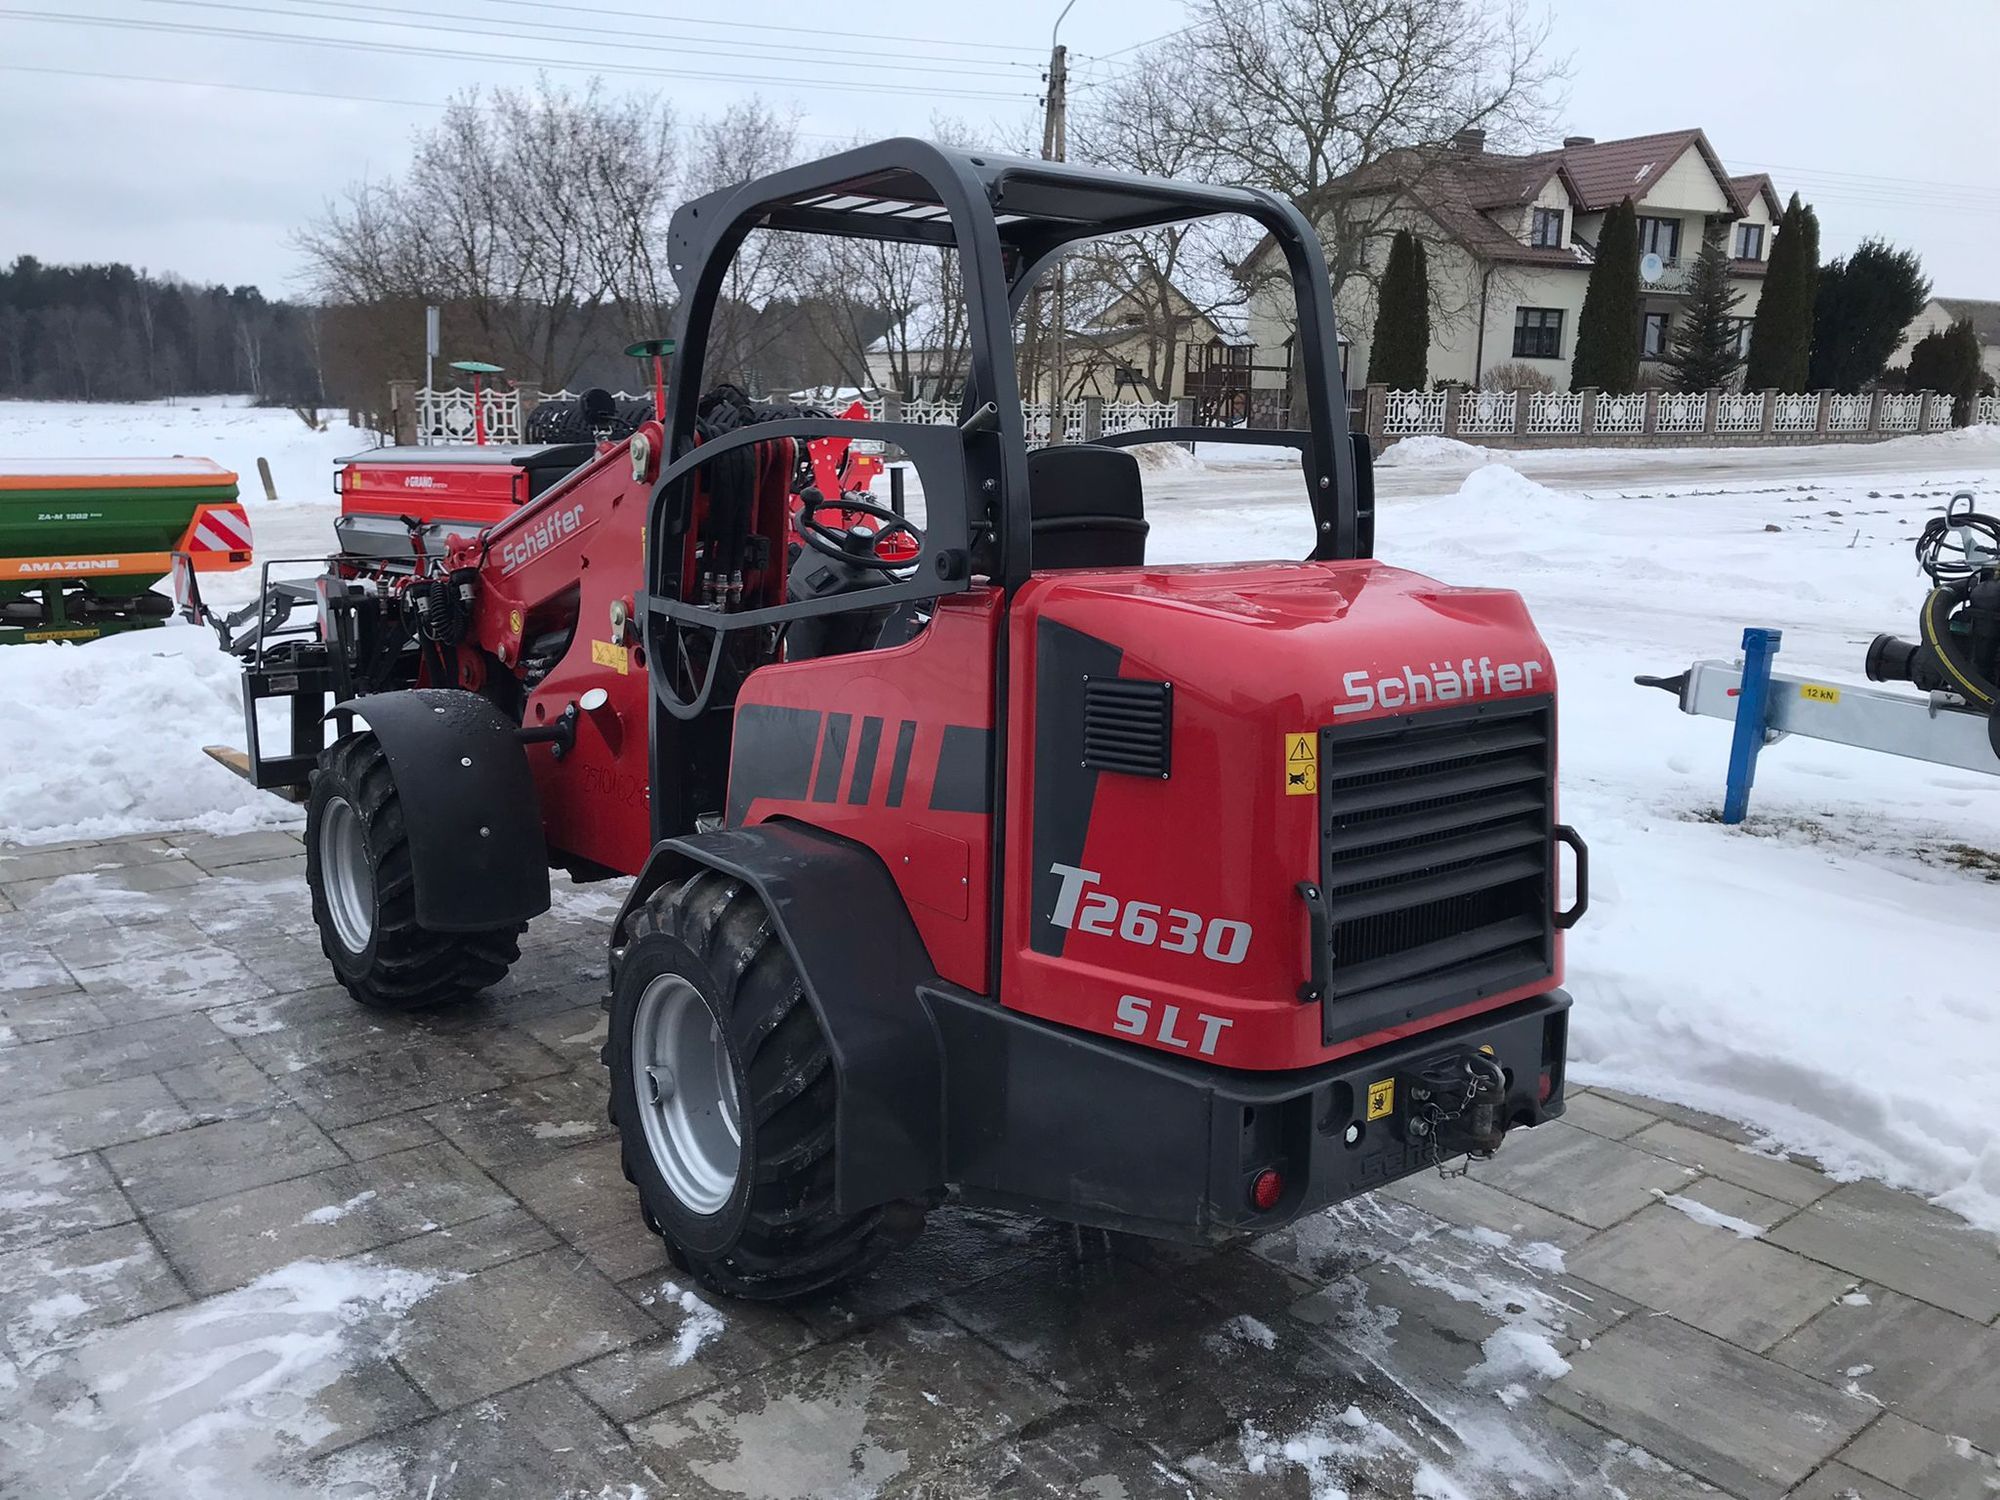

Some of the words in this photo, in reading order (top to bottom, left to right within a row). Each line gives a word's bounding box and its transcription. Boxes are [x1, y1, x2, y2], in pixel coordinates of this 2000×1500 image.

[18, 559, 120, 573] AMAZONE
[501, 503, 585, 575] Schäffer
[1332, 656, 1543, 716] Schäffer
[1806, 688, 1819, 698] 12
[1820, 690, 1834, 700] kN
[1049, 862, 1253, 965] T2630
[1113, 994, 1234, 1056] SLT
